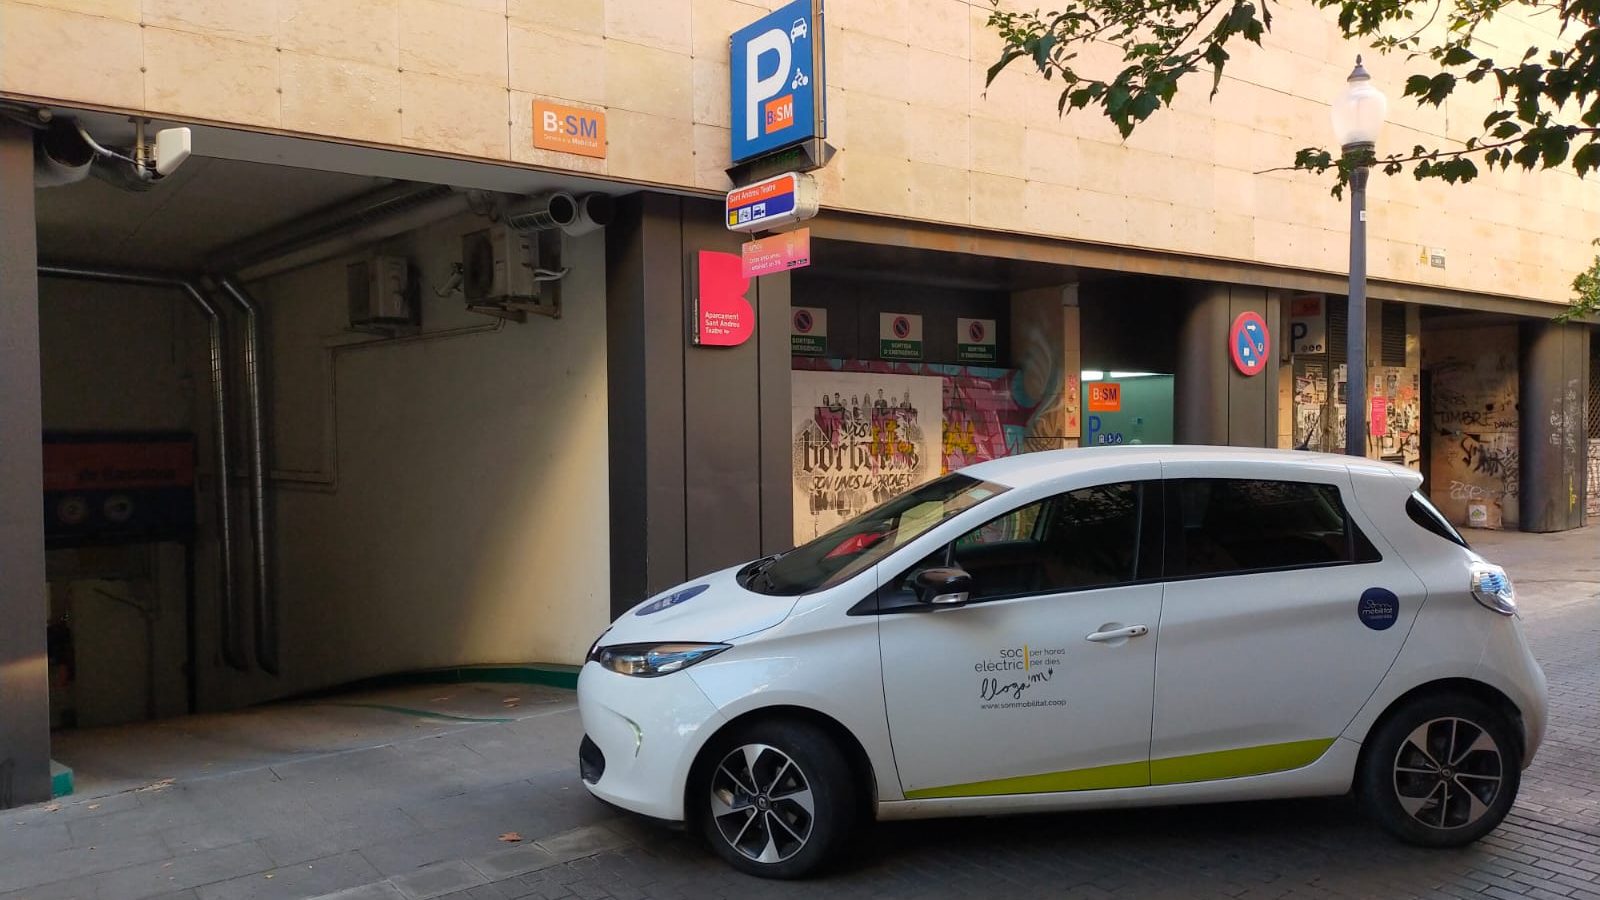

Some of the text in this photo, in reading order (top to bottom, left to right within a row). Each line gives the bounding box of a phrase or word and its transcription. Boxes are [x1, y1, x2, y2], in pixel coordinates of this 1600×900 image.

[746, 28, 792, 141] P
[767, 102, 793, 125] B:SM
[543, 110, 597, 139] B:SM
[705, 311, 739, 321] Aparcament
[705, 319, 740, 328] Sant Andreu
[1291, 323, 1307, 352] P
[1093, 387, 1117, 401] B:SM
[1089, 415, 1101, 445] P
[1044, 648, 1066, 656] hores
[974, 660, 1024, 672] electric
[1044, 658, 1061, 666] dies
